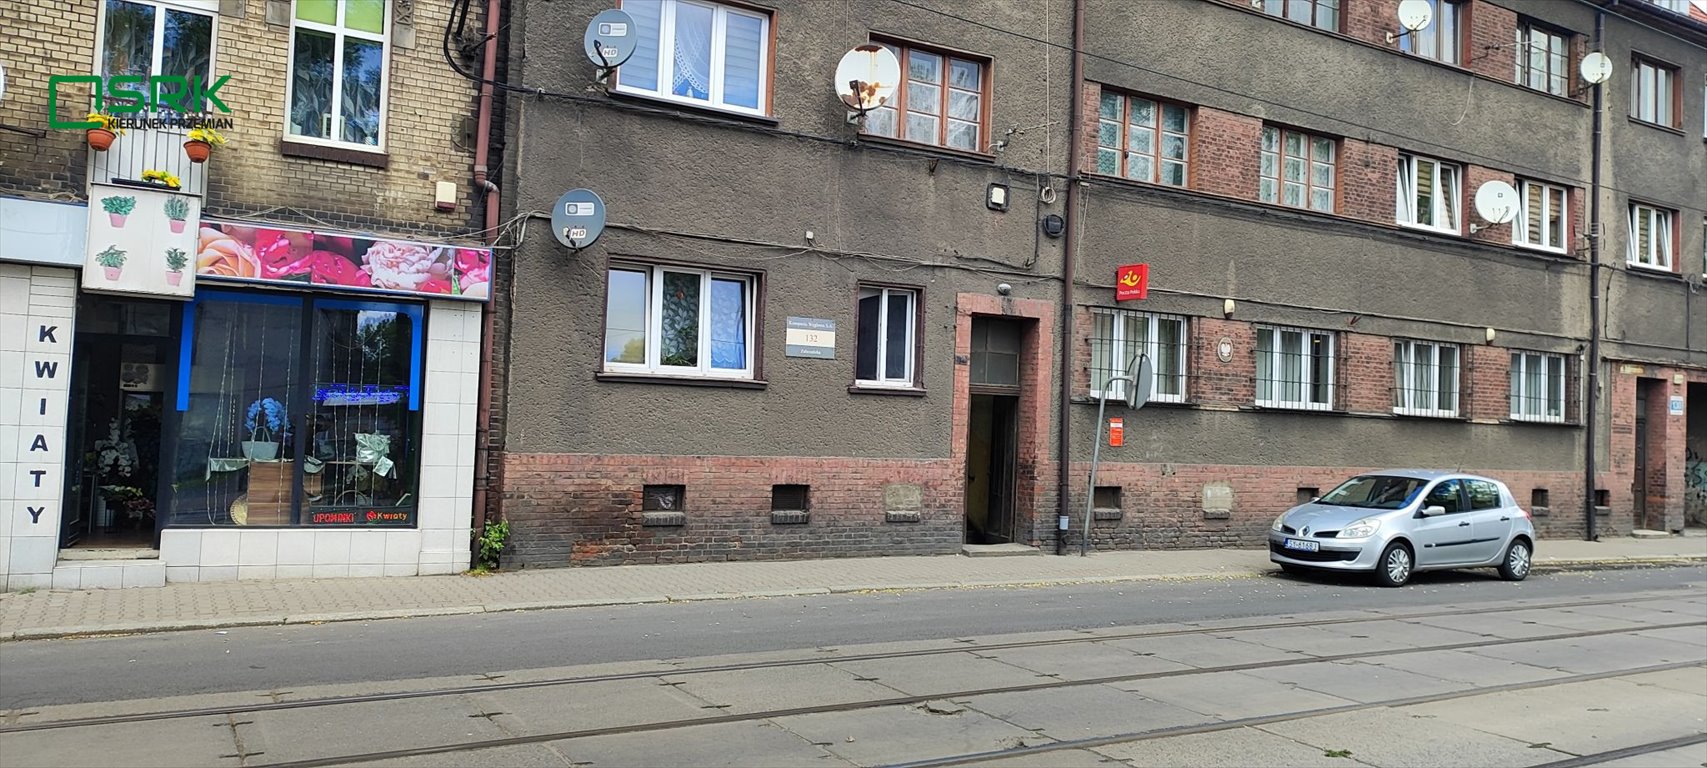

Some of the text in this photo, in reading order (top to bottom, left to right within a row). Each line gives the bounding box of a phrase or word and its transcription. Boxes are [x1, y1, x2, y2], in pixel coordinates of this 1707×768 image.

[806, 334, 818, 342] 132
[27, 325, 58, 524] KWIATY
[314, 512, 354, 523] UPOMINKI
[378, 512, 408, 520] Kwiaty
